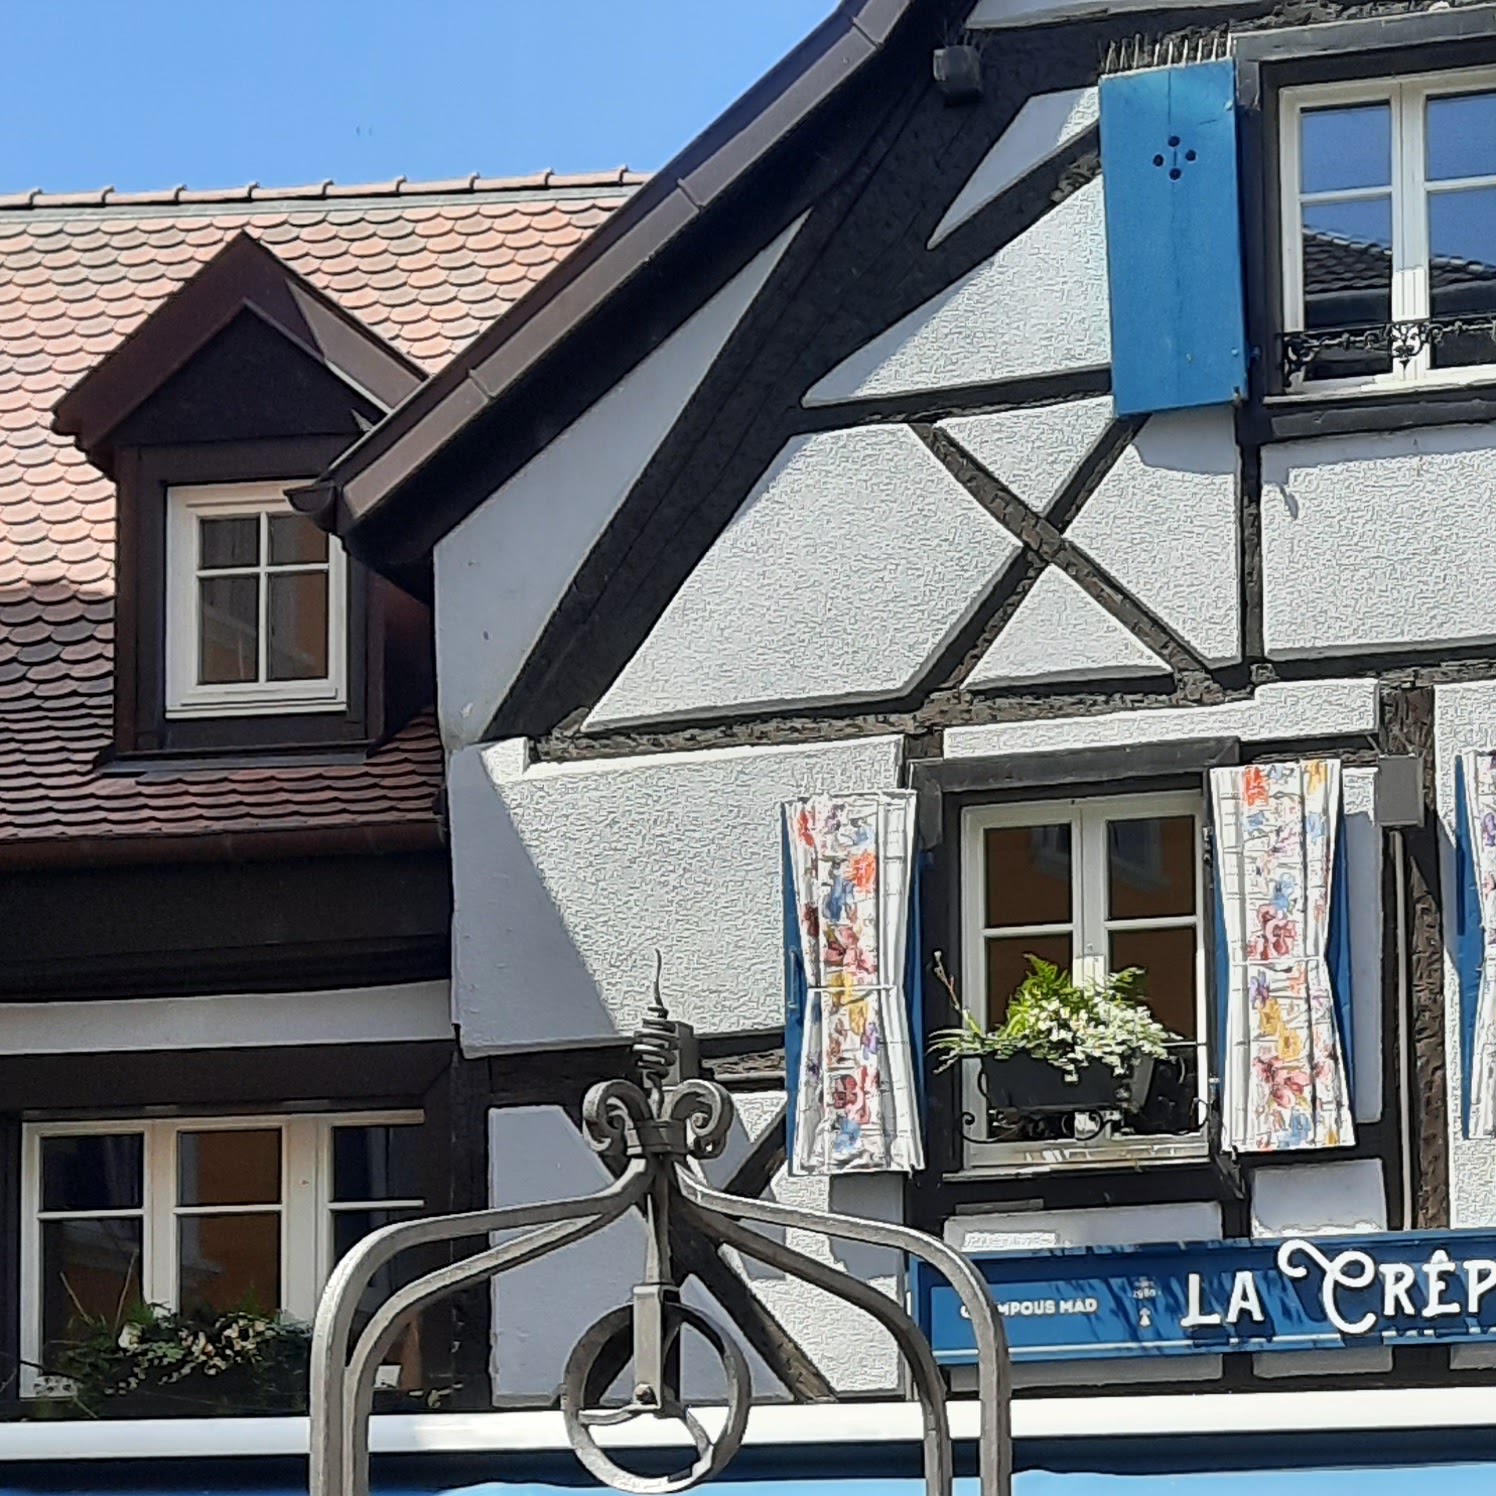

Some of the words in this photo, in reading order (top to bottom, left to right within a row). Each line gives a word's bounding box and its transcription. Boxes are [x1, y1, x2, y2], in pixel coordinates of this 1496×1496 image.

[960, 1300, 1055, 1318] CMPOUS
[1060, 1298, 1098, 1314] MAD
[1180, 1270, 1265, 1328] LA
